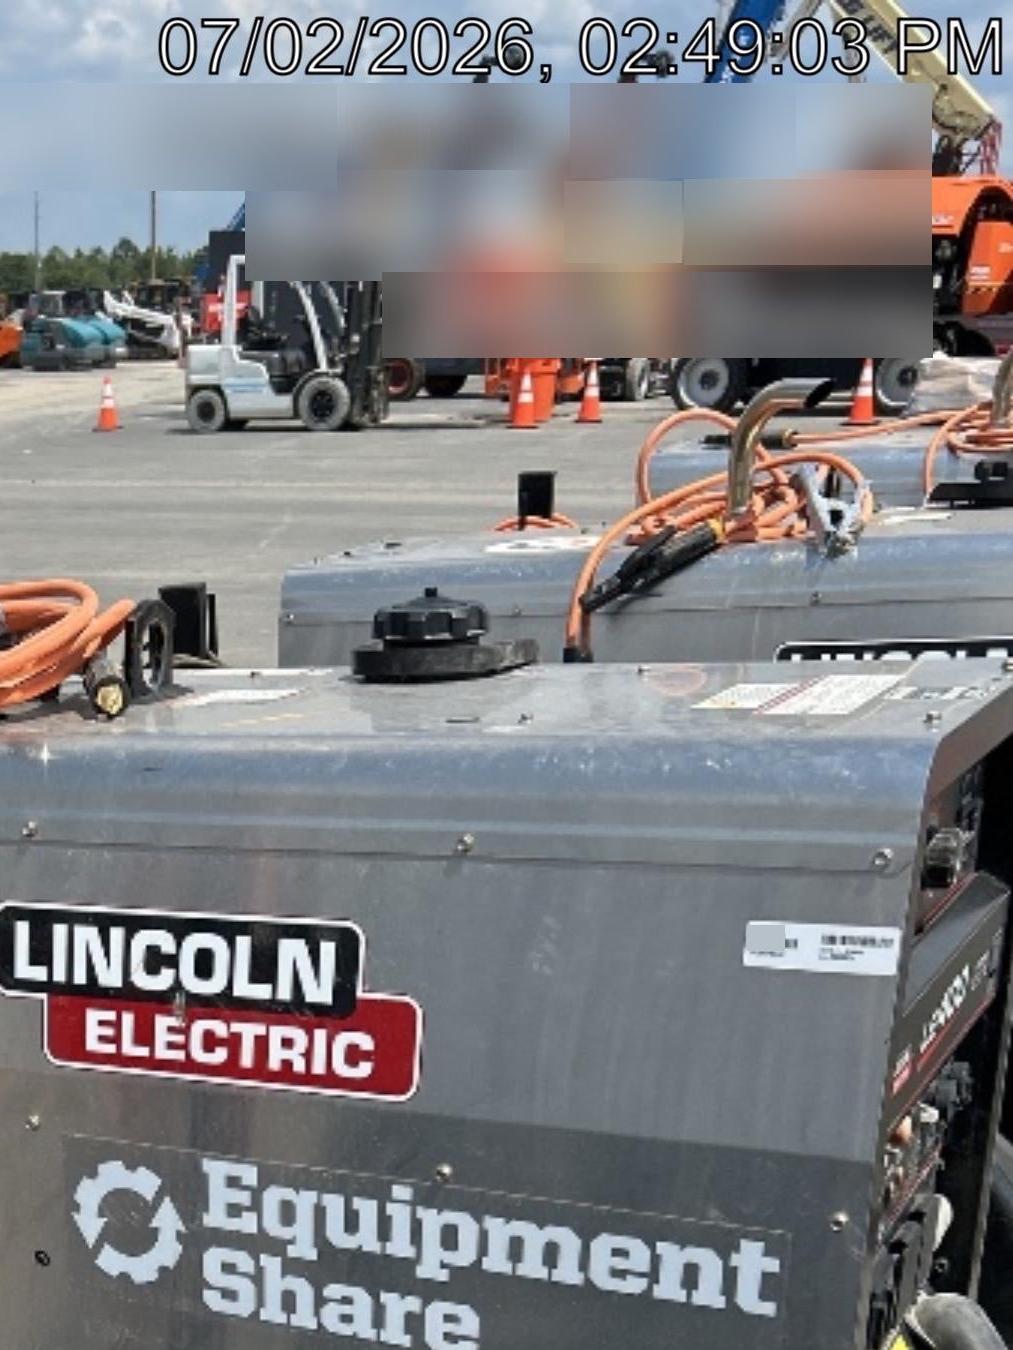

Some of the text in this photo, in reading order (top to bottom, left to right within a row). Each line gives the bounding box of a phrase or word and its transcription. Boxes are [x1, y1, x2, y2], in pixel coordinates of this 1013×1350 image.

[13, 920, 336, 1006] LINCOLN
[85, 1007, 375, 1079] ELECTRIC
[201, 1158, 781, 1317] Equipment
